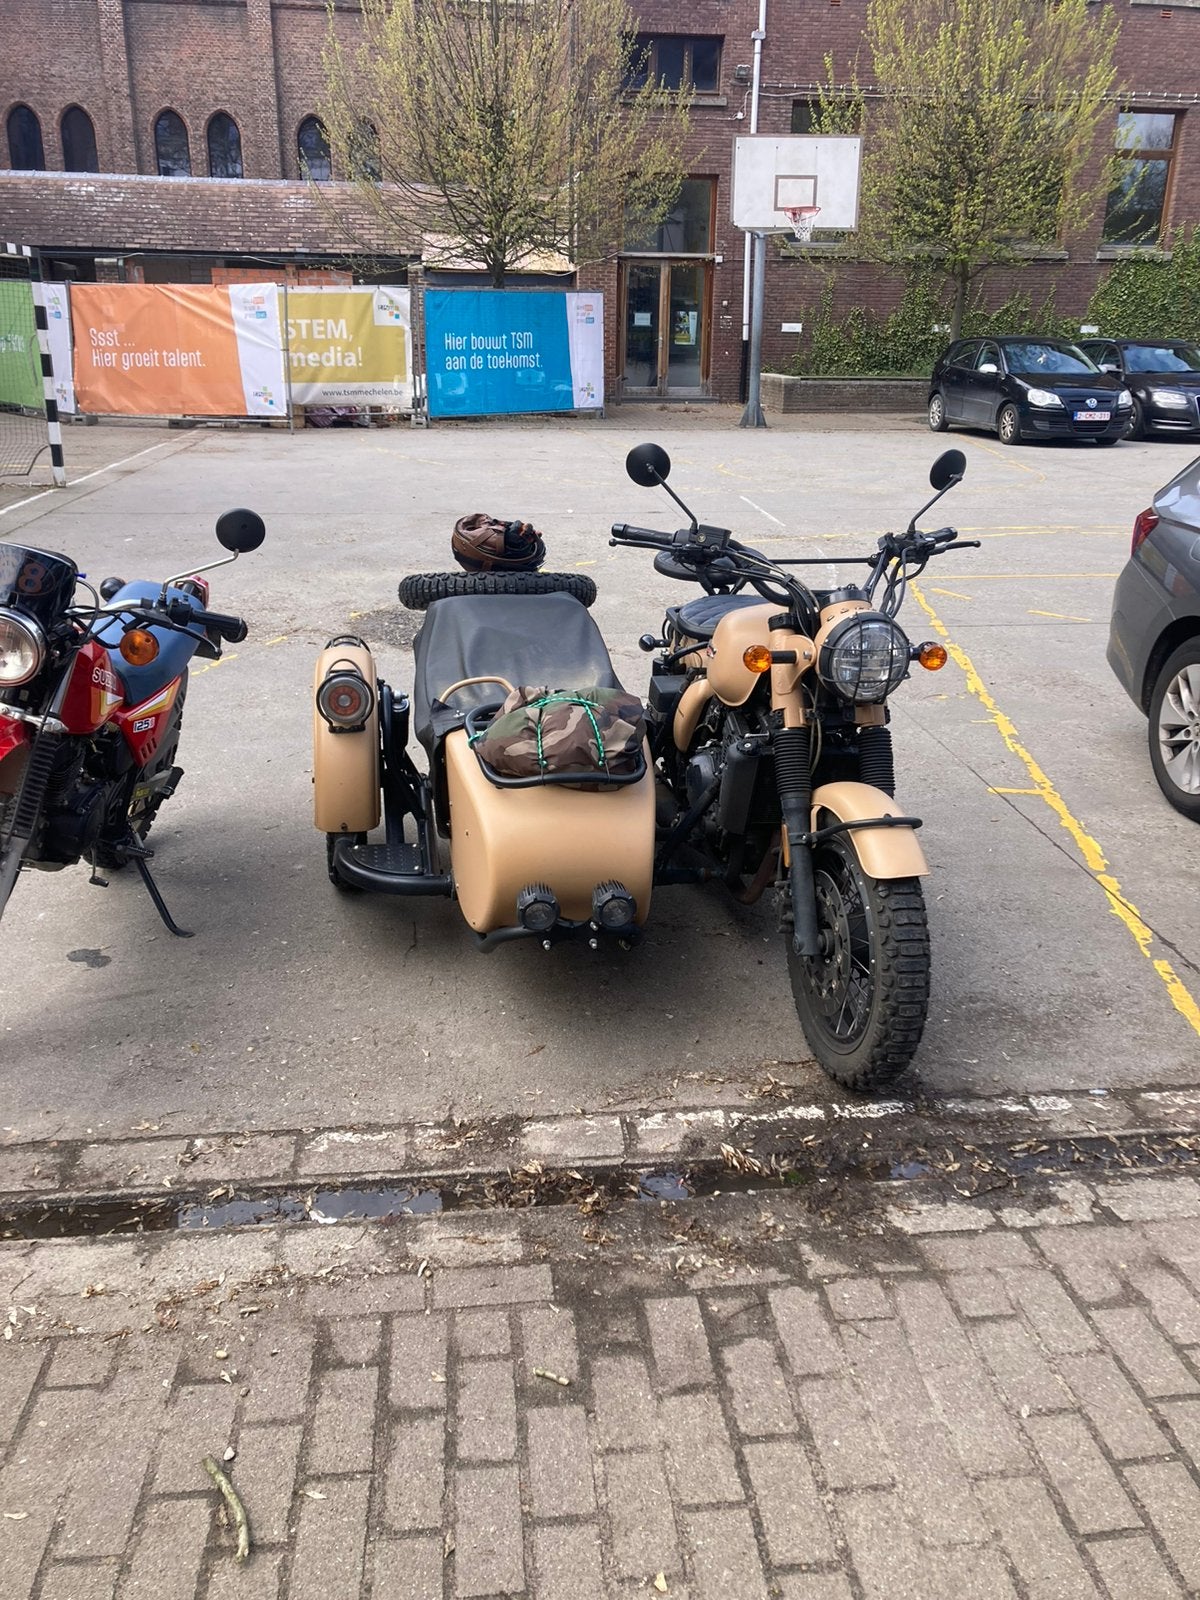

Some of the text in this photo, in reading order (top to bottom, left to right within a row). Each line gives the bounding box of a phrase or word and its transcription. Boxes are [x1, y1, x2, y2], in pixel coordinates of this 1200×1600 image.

[89, 327, 120, 346] Ssst
[283, 318, 353, 342] STEM,
[444, 331, 533, 350] Hier bouwt TSM
[92, 348, 206, 370] Hier groeit talent.
[286, 346, 363, 368] media!
[445, 351, 543, 370] aan de toekomst.
[322, 388, 403, 396] www.tsmmechelen.be
